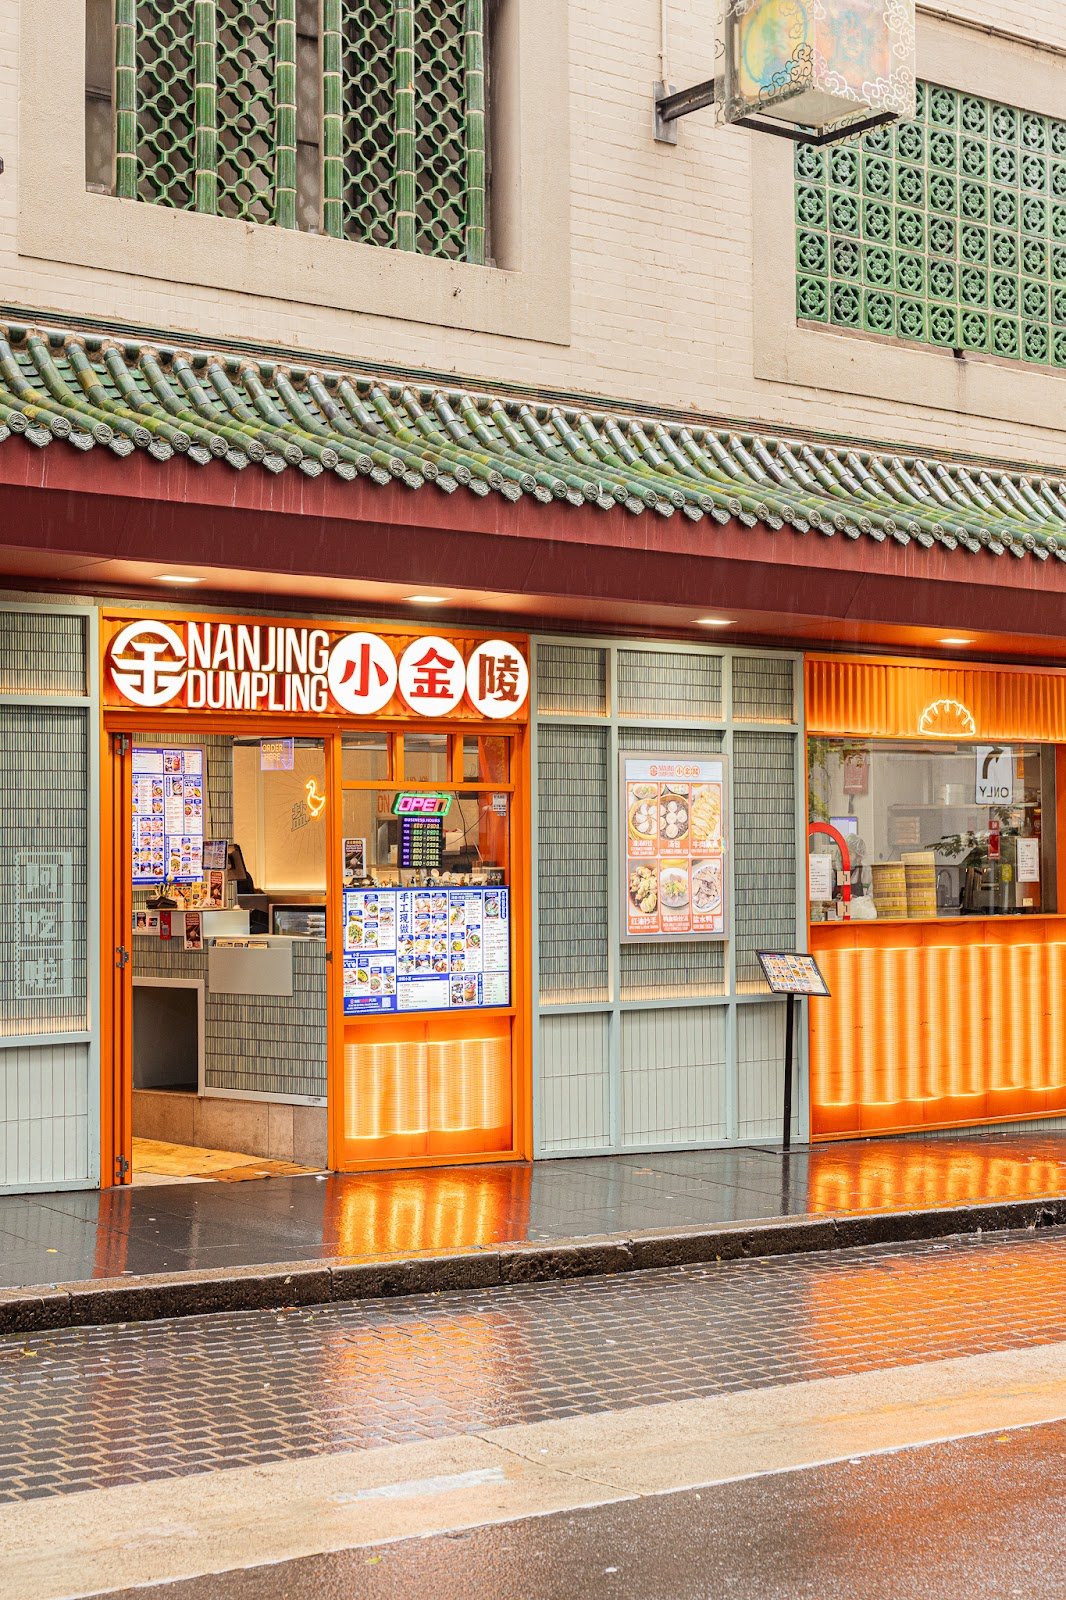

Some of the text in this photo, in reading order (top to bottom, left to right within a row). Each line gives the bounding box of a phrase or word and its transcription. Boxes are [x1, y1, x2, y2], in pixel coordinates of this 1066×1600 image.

[187, 620, 329, 673] NANJING
[187, 669, 328, 712] DUMPLING
[339, 643, 519, 702] 小金陵
[262, 744, 283, 752] ORDER
[398, 797, 448, 812] OPEN
